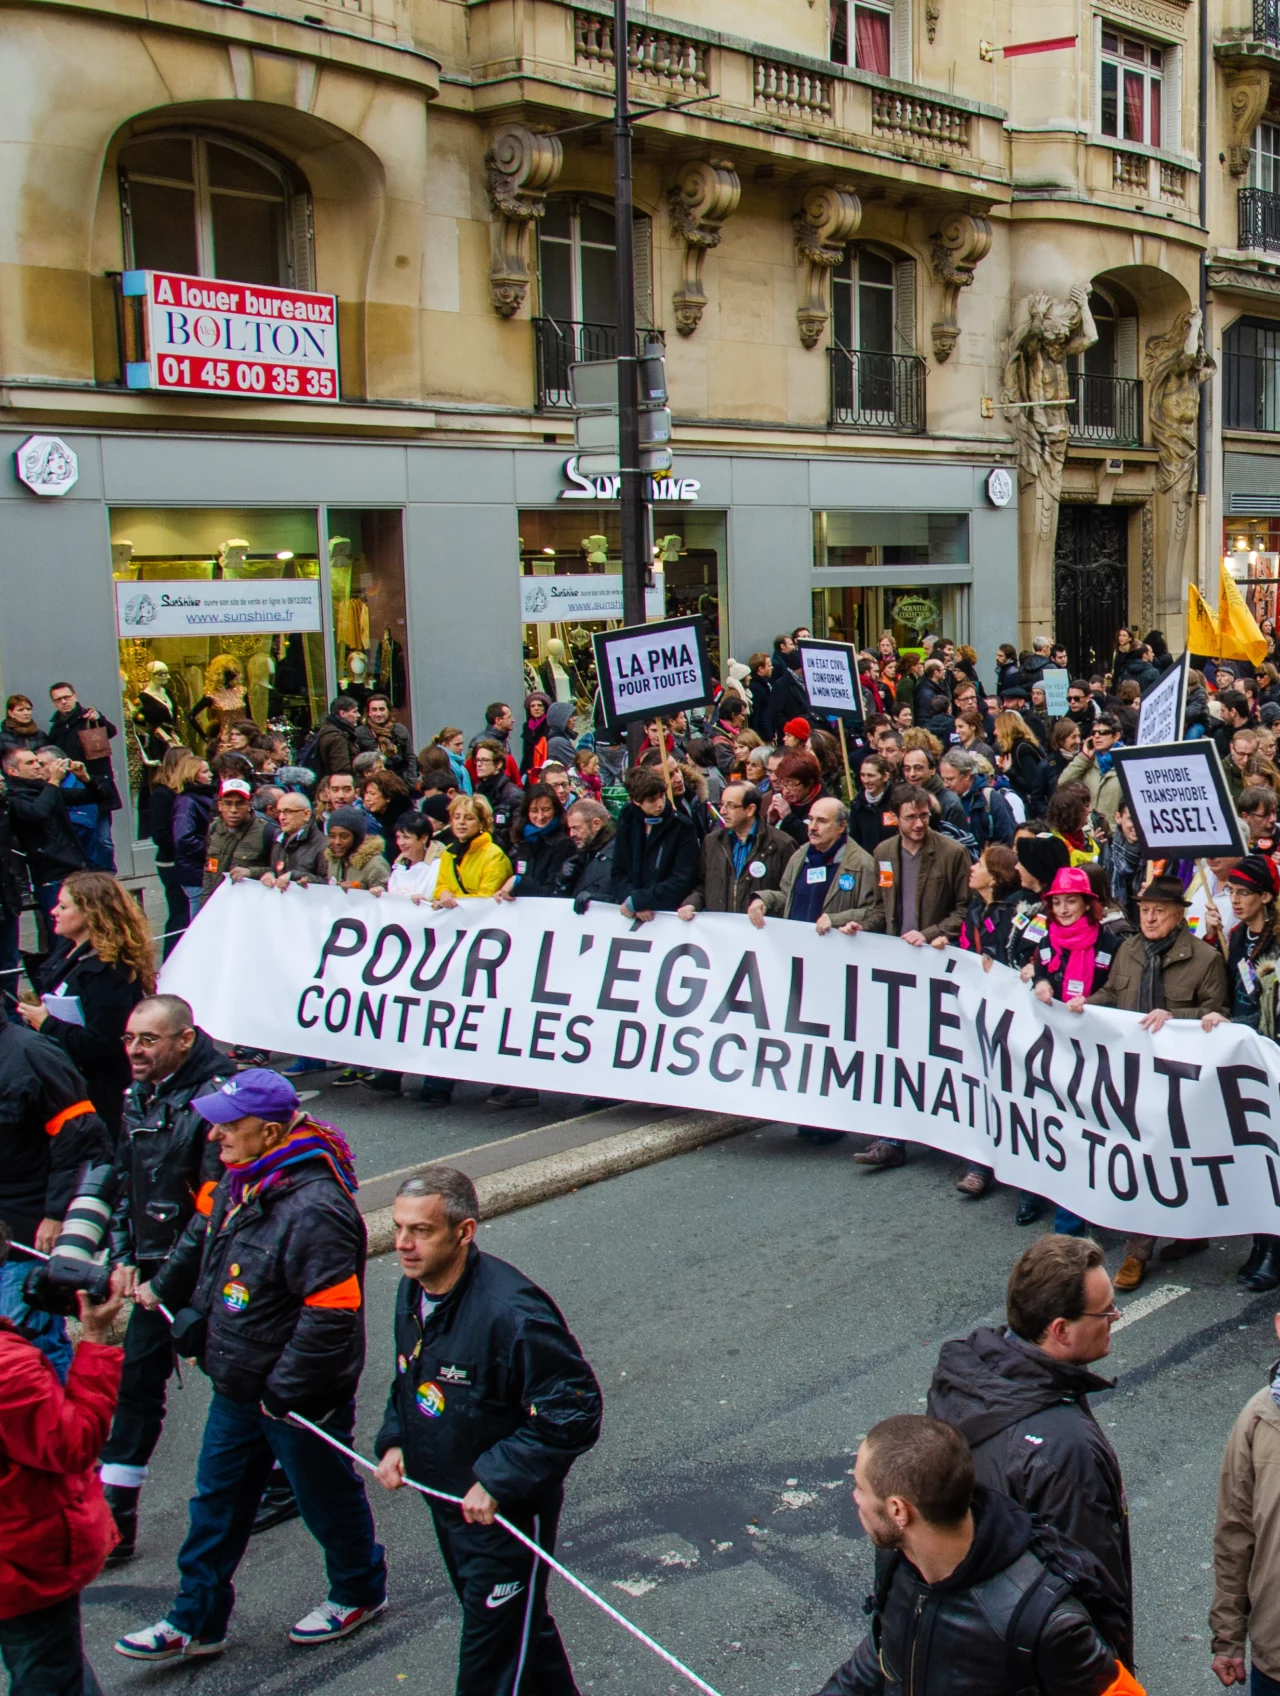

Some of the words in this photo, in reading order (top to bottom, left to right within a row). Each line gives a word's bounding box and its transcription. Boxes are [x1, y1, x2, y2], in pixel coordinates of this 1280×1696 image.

[157, 279, 175, 304] A
[181, 281, 239, 311] louer
[245, 290, 332, 322] bureaux
[165, 311, 326, 358] BOLTON
[162, 357, 191, 384] 01
[200, 361, 230, 388] 45
[236, 364, 265, 391] 00
[271, 367, 299, 393] 35
[306, 369, 333, 396] 35
[230, 598, 240, 606] site
[248, 598, 261, 606] vente
[186, 610, 295, 623] www.sunshine.fr
[616, 653, 645, 680] LA
[649, 643, 694, 674] PMA
[807, 657, 816, 668] UN
[815, 657, 830, 670] ÉTAT
[830, 659, 846, 671] CIVIL
[618, 677, 651, 698] POUR
[653, 669, 697, 692] TOUTES
[812, 671, 845, 685] CONFORME
[818, 686, 830, 698] MON
[830, 687, 850, 699] GENRE
[1144, 767, 1192, 785] BIPHOBIE
[1140, 786, 1209, 804] TRANSPHOBIE
[1149, 807, 1207, 834] ASSEZ
[1206, 806, 1218, 832] !
[313, 917, 512, 999] POUR
[530, 918, 964, 1062] L'ÉGALITÉ
[298, 984, 485, 1052] CONTRE
[497, 1007, 595, 1064] LES
[612, 1018, 1067, 1172] DISCRIMINATIONS
[1080, 1130, 1236, 1208] TOUT
[229, 1290, 243, 1306] 31
[422, 1390, 441, 1412] 31
[492, 1580, 520, 1597] NIKE
